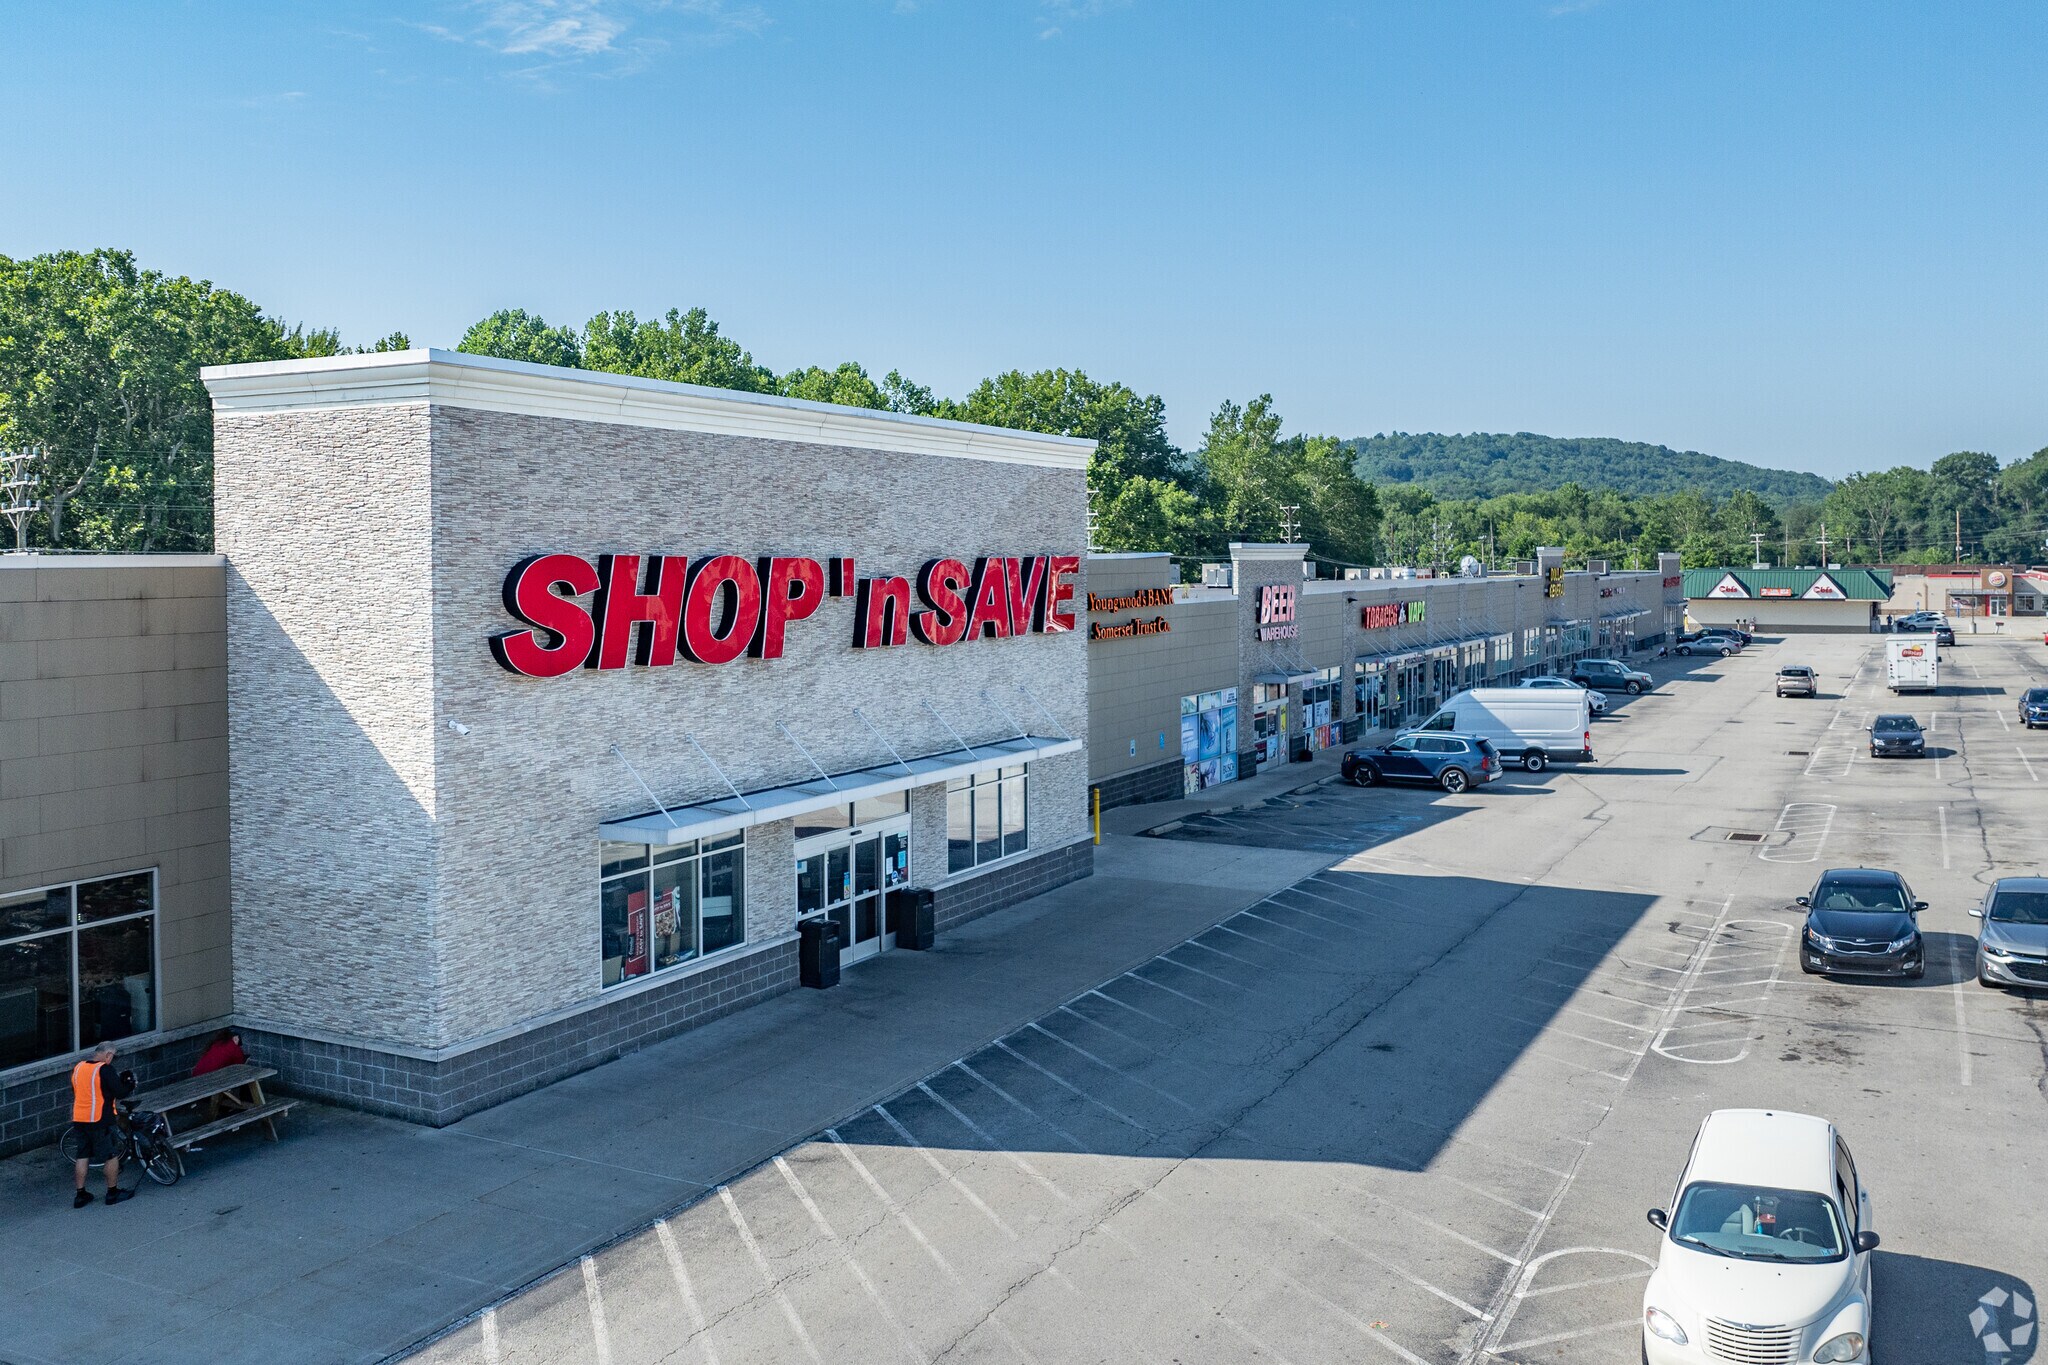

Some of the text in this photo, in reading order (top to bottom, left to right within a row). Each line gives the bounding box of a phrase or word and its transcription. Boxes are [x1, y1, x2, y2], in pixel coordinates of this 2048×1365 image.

[1088, 587, 1174, 613] Youngwood's BANK
[1260, 585, 1296, 624] BEER
[496, 554, 824, 677] SHOP
[917, 556, 1080, 645] SAVE
[1365, 600, 1425, 629] TOBACCO VAPE
[1094, 621, 1134, 640] Somerset
[1135, 617, 1157, 636] Trust
[1260, 625, 1299, 641] WAREHOUSE
